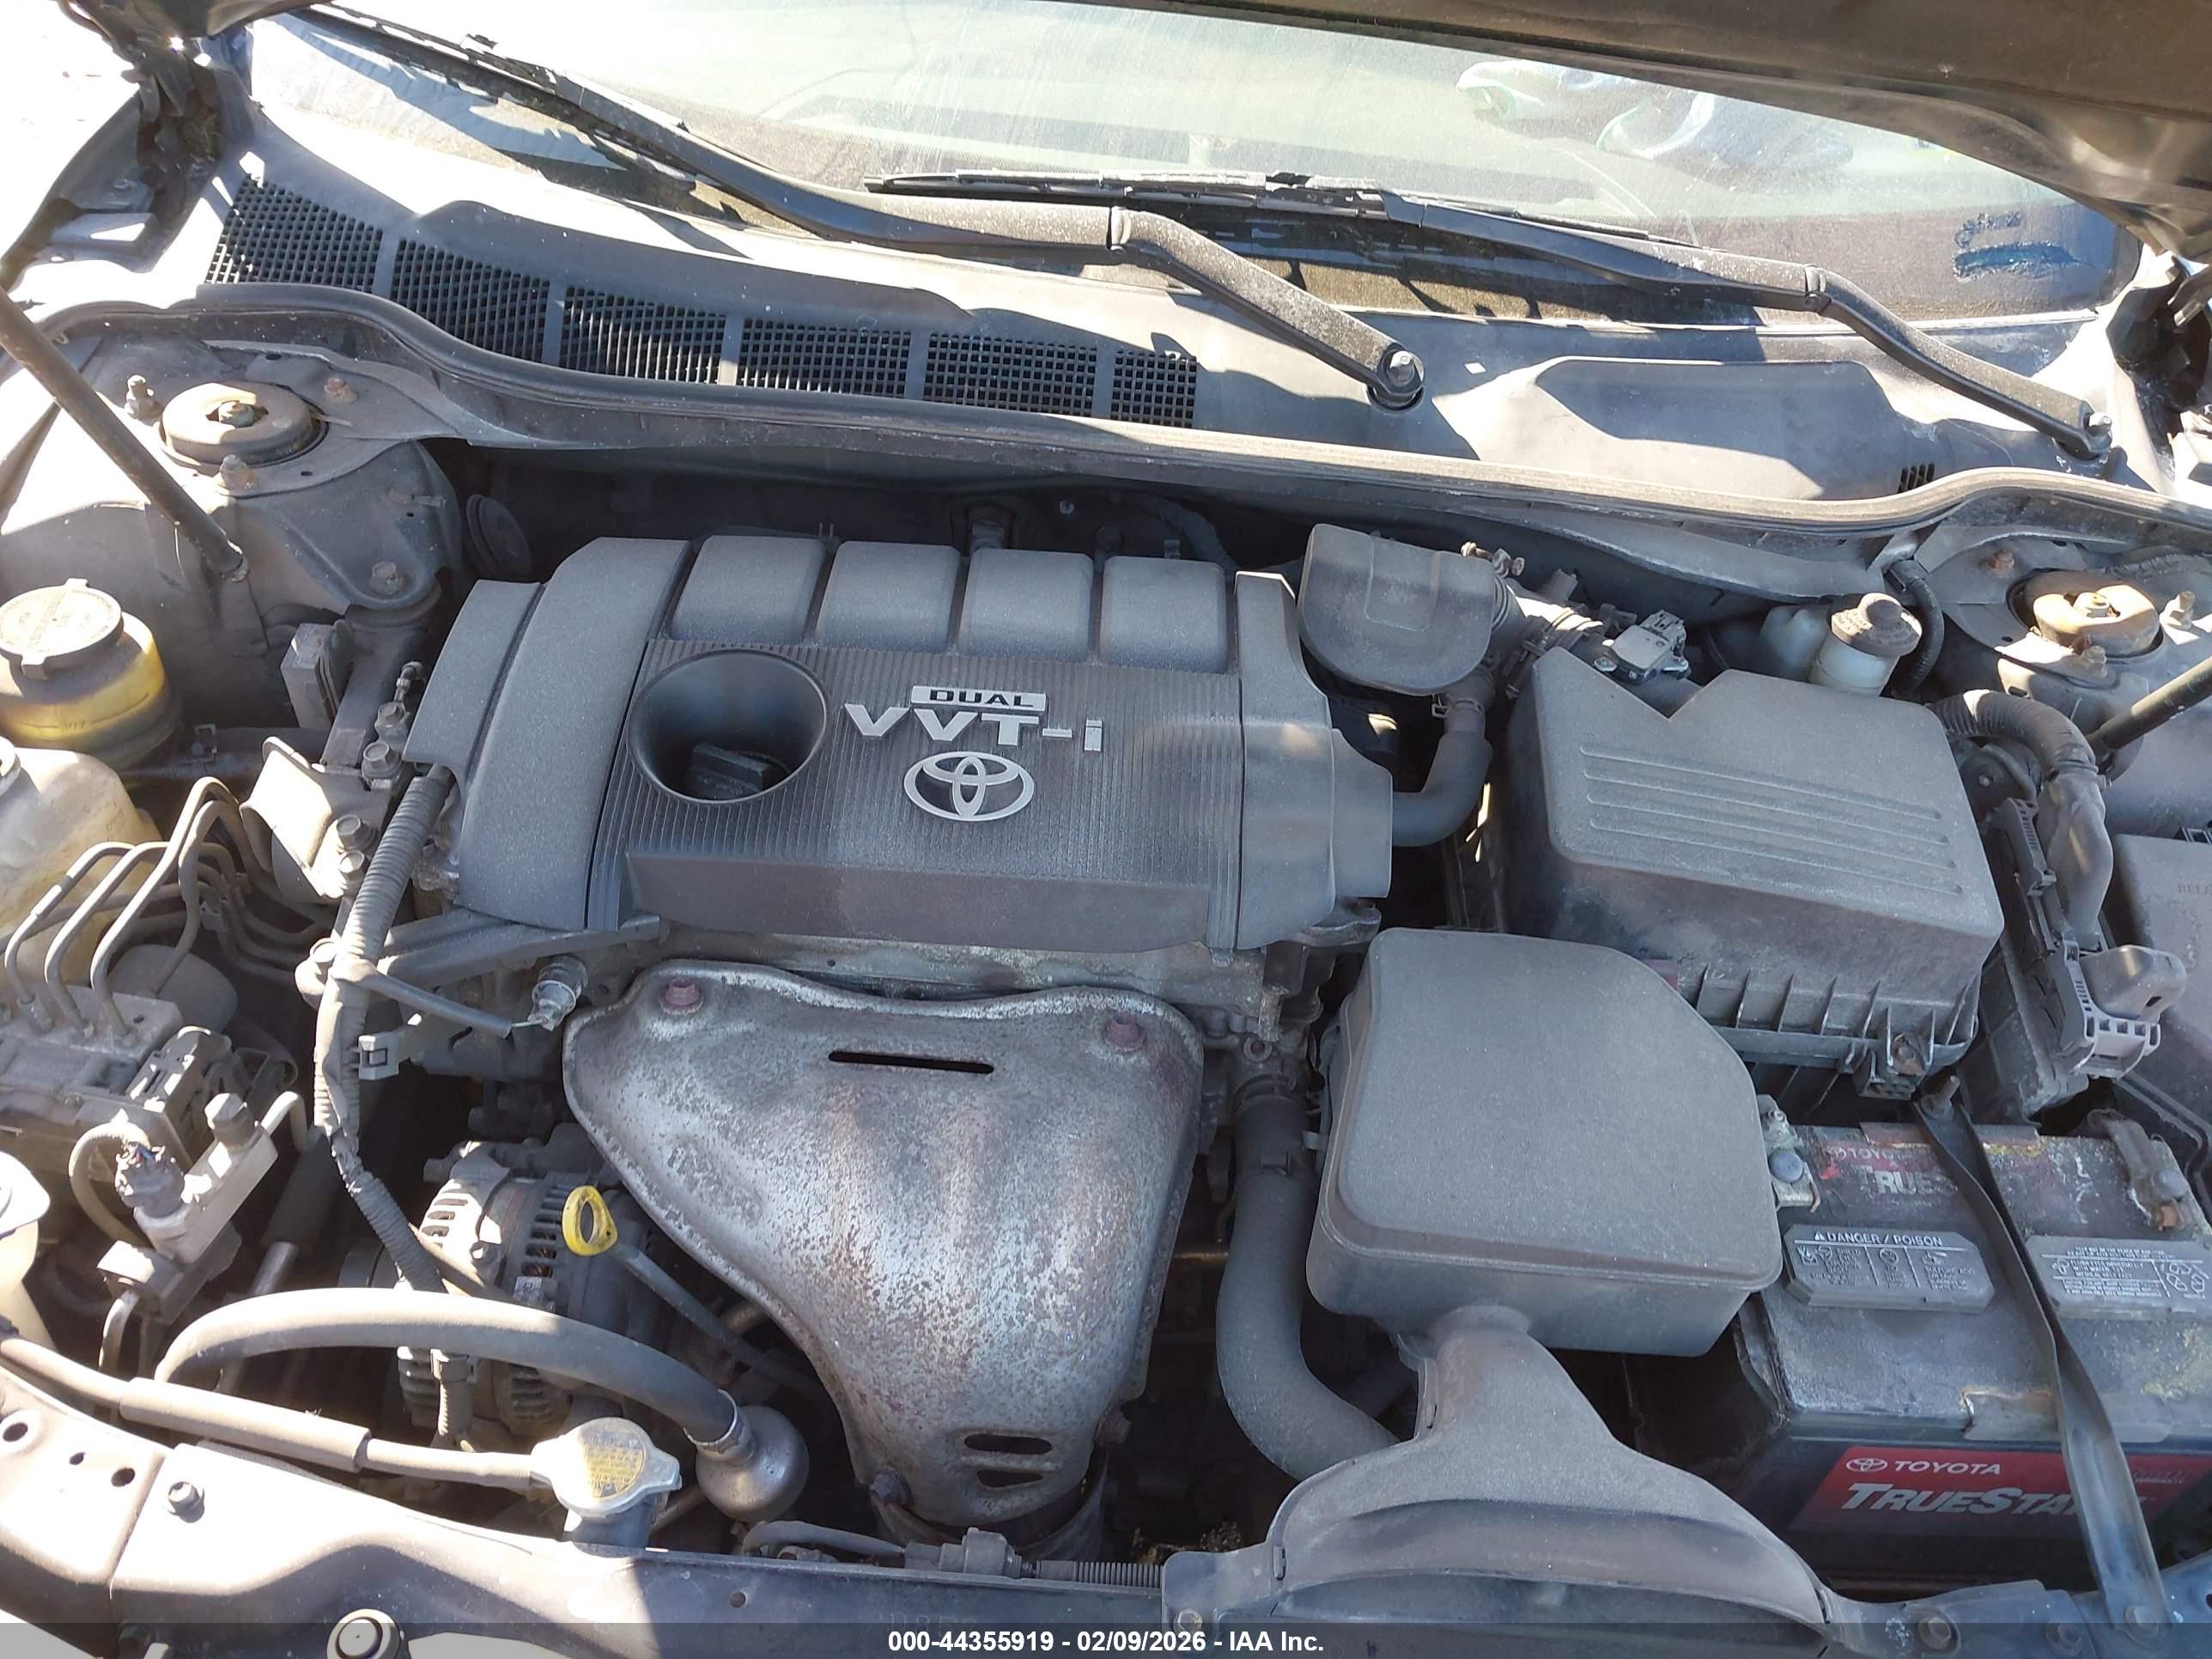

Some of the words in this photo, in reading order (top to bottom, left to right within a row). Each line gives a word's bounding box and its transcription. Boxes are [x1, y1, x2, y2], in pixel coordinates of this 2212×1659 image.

[929, 689, 1034, 708] DUAL
[844, 703, 1103, 752] VVT-i
[1826, 1232, 1880, 1244] DANGER
[1893, 1235, 1942, 1246] POISON
[1894, 1461, 2001, 1474] TOYOTA
